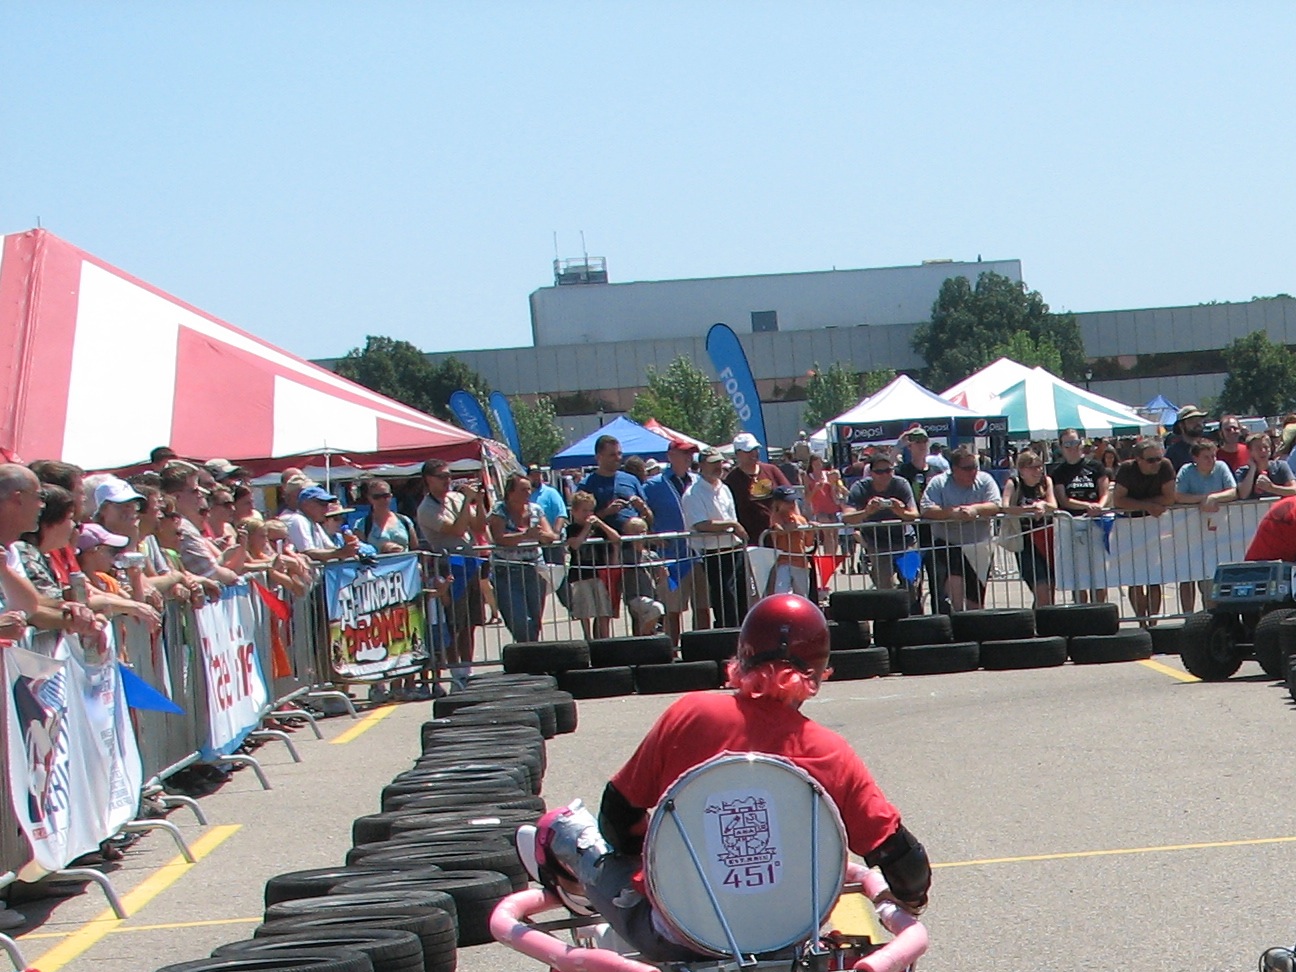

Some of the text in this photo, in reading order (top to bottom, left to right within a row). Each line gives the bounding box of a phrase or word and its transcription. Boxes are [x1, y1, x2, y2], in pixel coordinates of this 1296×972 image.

[719, 366, 751, 422] FOOD
[853, 425, 884, 439] pepsi
[923, 423, 950, 437] pepsi
[338, 571, 407, 624] THUNDER
